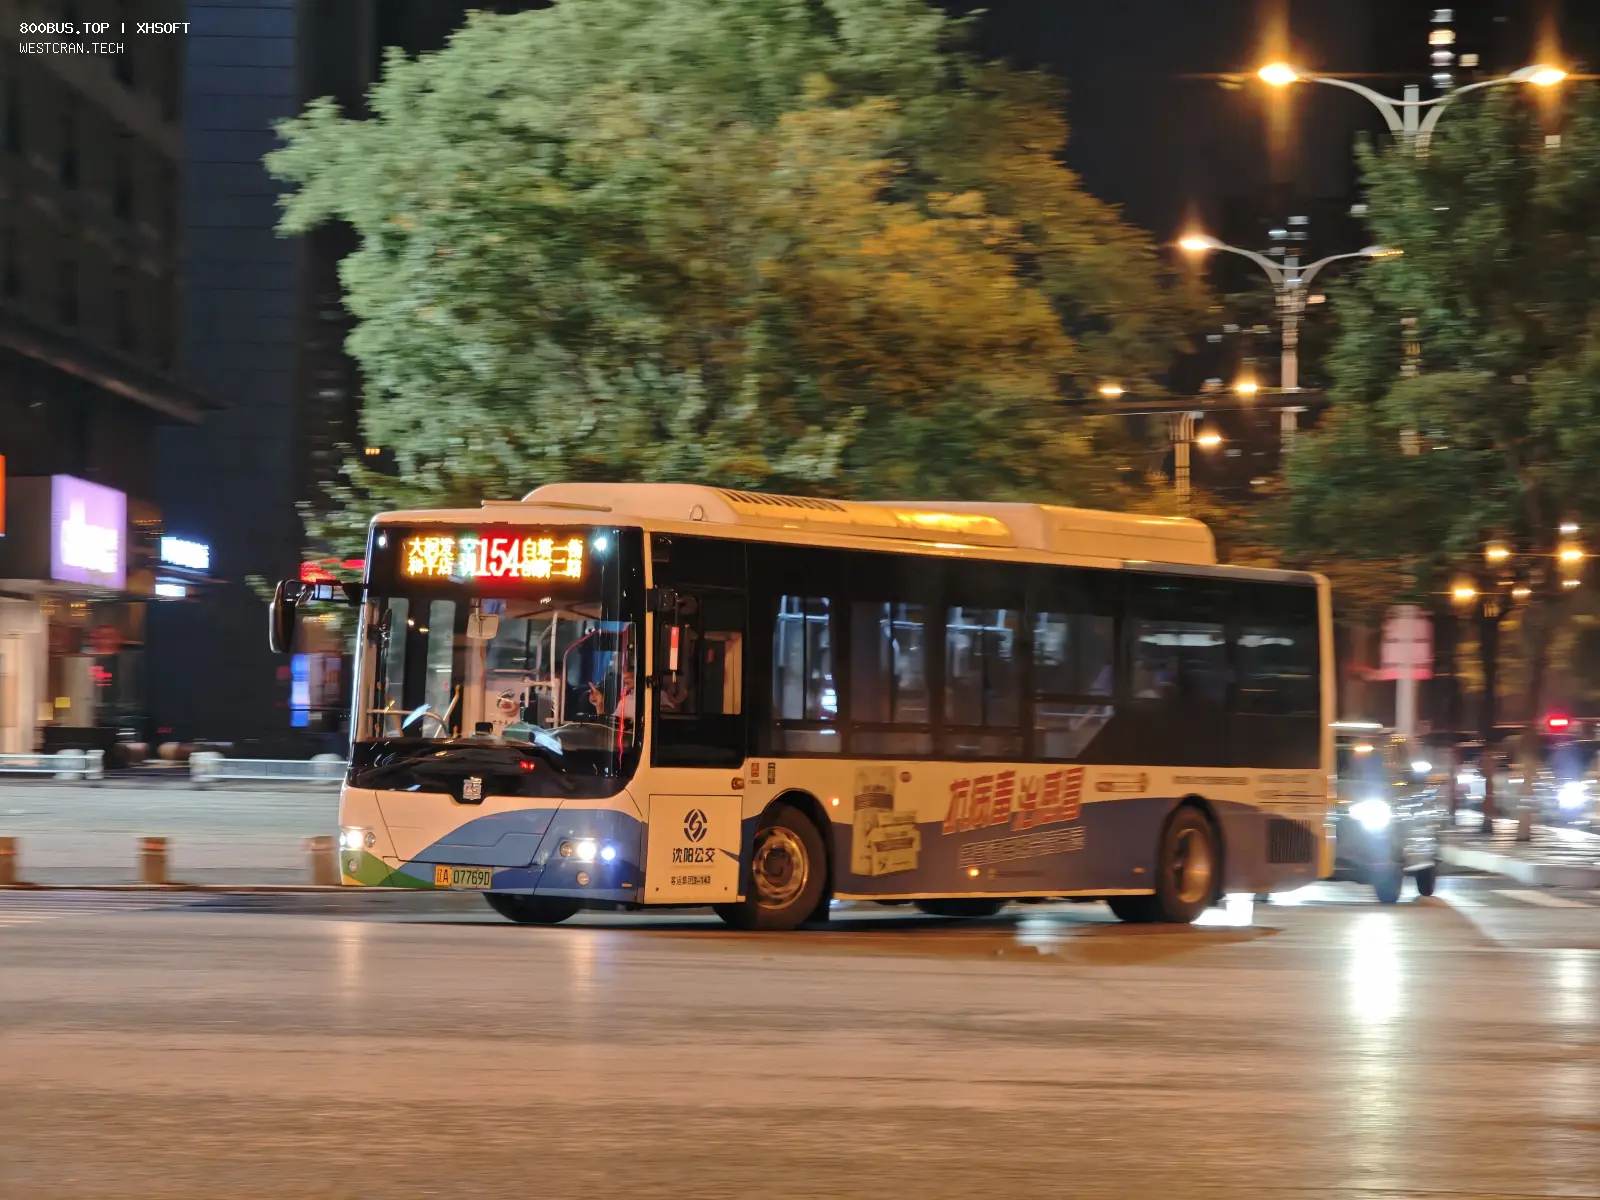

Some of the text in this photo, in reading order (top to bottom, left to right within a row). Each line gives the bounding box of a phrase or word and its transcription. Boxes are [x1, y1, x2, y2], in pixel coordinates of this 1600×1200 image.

[475, 538, 523, 577] 154
[672, 847, 716, 863] 沈阳公交
